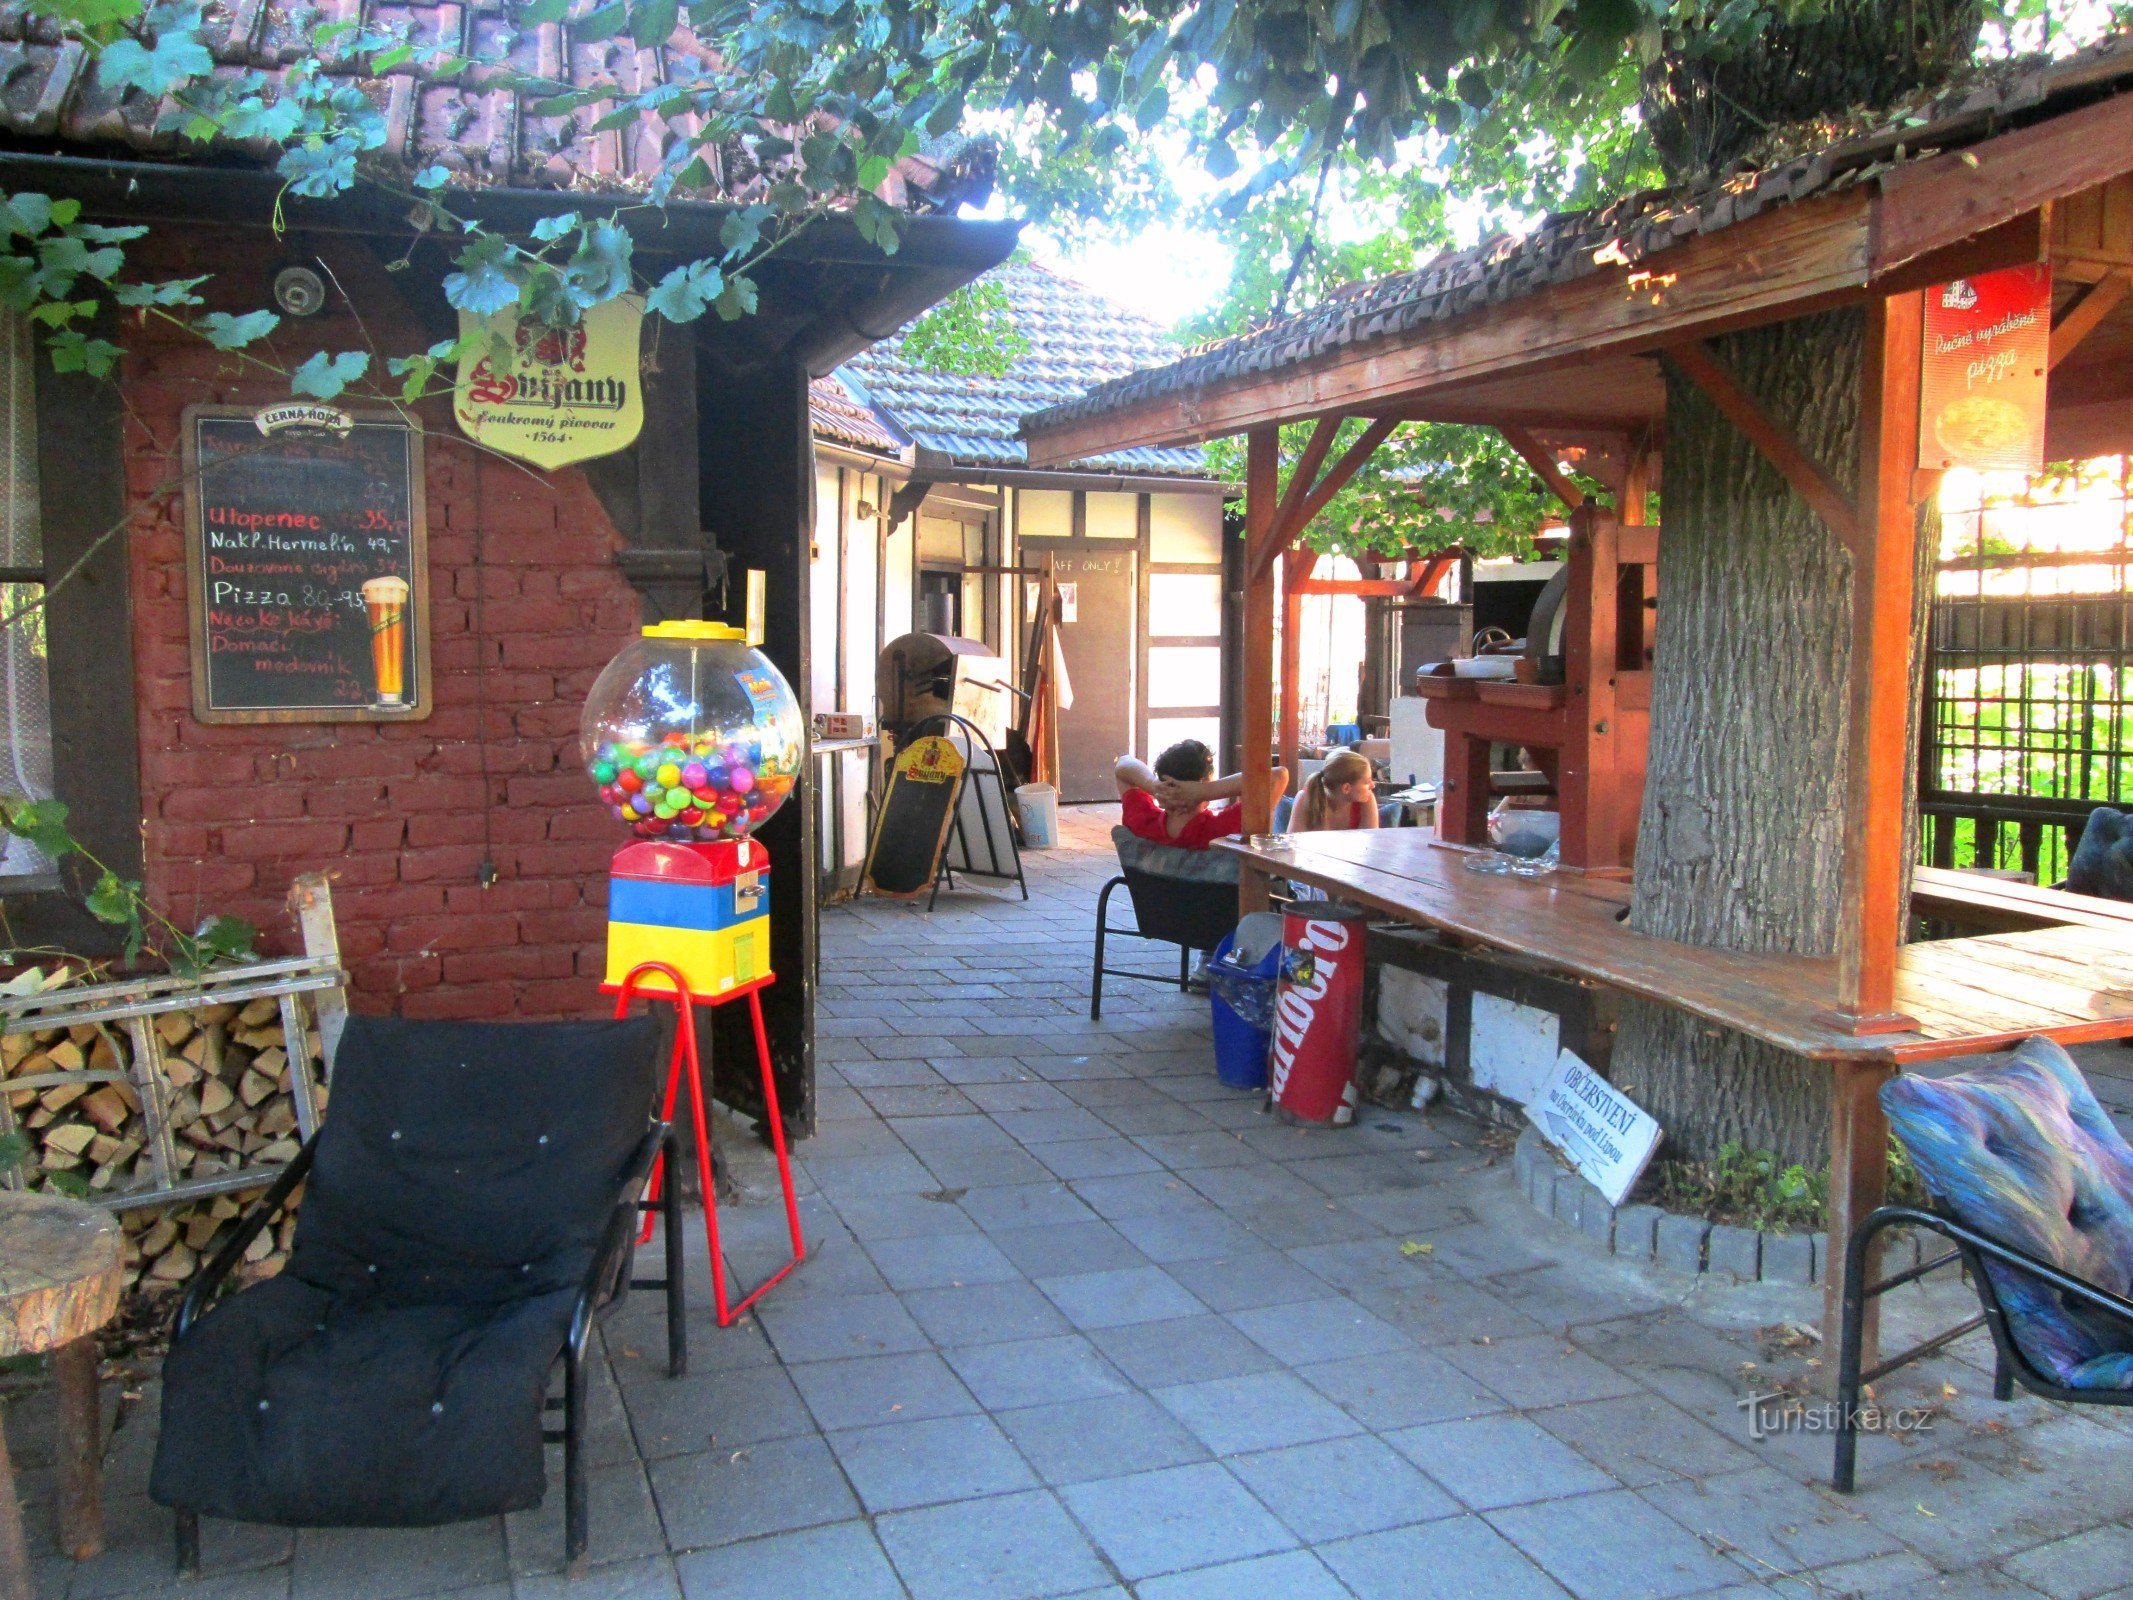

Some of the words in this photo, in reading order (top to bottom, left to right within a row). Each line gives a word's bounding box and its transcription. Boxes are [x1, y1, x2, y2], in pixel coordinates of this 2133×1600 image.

[1935, 329, 1973, 354] Ručně
[1967, 349, 2016, 390] pizza
[468, 356, 626, 411] Svijany
[559, 416, 615, 430] pivovar
[532, 432, 567, 443] 1564
[209, 508, 321, 531] Utopenec
[214, 581, 291, 604] Pizza
[1272, 919, 1349, 1102] arlboro
